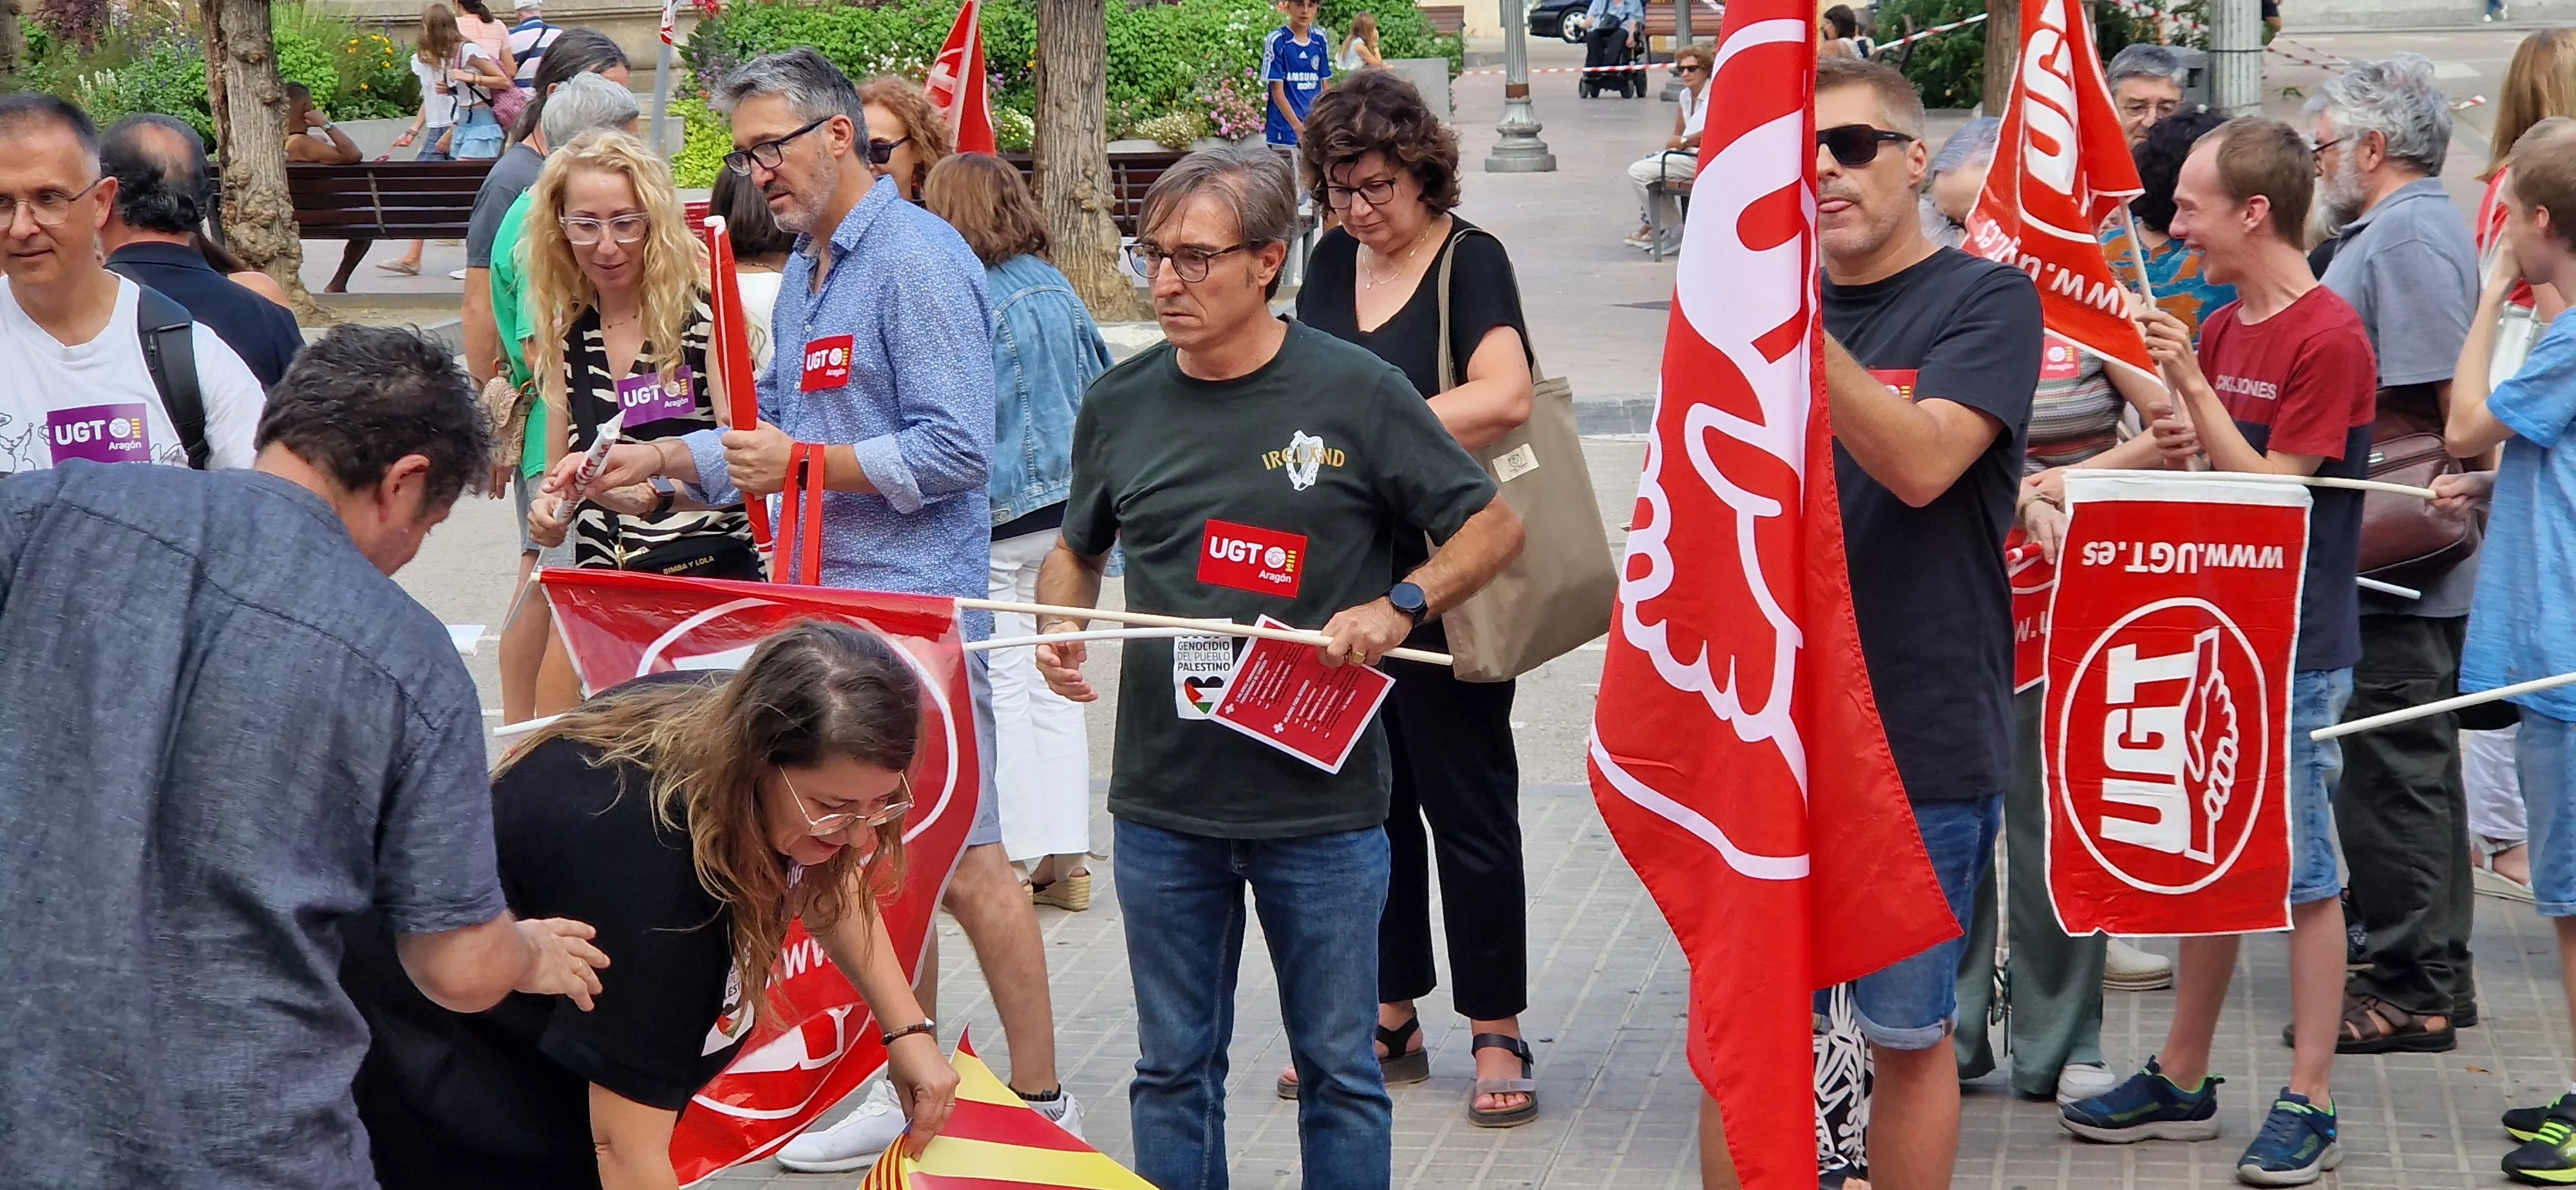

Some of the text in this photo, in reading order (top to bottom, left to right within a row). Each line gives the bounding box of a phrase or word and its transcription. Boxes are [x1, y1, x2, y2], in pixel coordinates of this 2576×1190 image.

[806, 349, 829, 371] UGT
[623, 384, 661, 407] UGT
[664, 397, 689, 408] Aragón
[55, 420, 106, 445] UGT
[108, 440, 142, 451] Aragón
[1209, 536, 1263, 564] UGT
[695, 555, 715, 566] LOLA
[2082, 541, 2284, 574] www.UGT.es
[1258, 570, 1291, 583] Aragón
[1178, 641, 1229, 651] GENOCIDIO
[1178, 652, 1230, 661] DEL PUEBLO
[1177, 663, 1231, 671] PALESTINO
[2101, 643, 2197, 854] UGT
